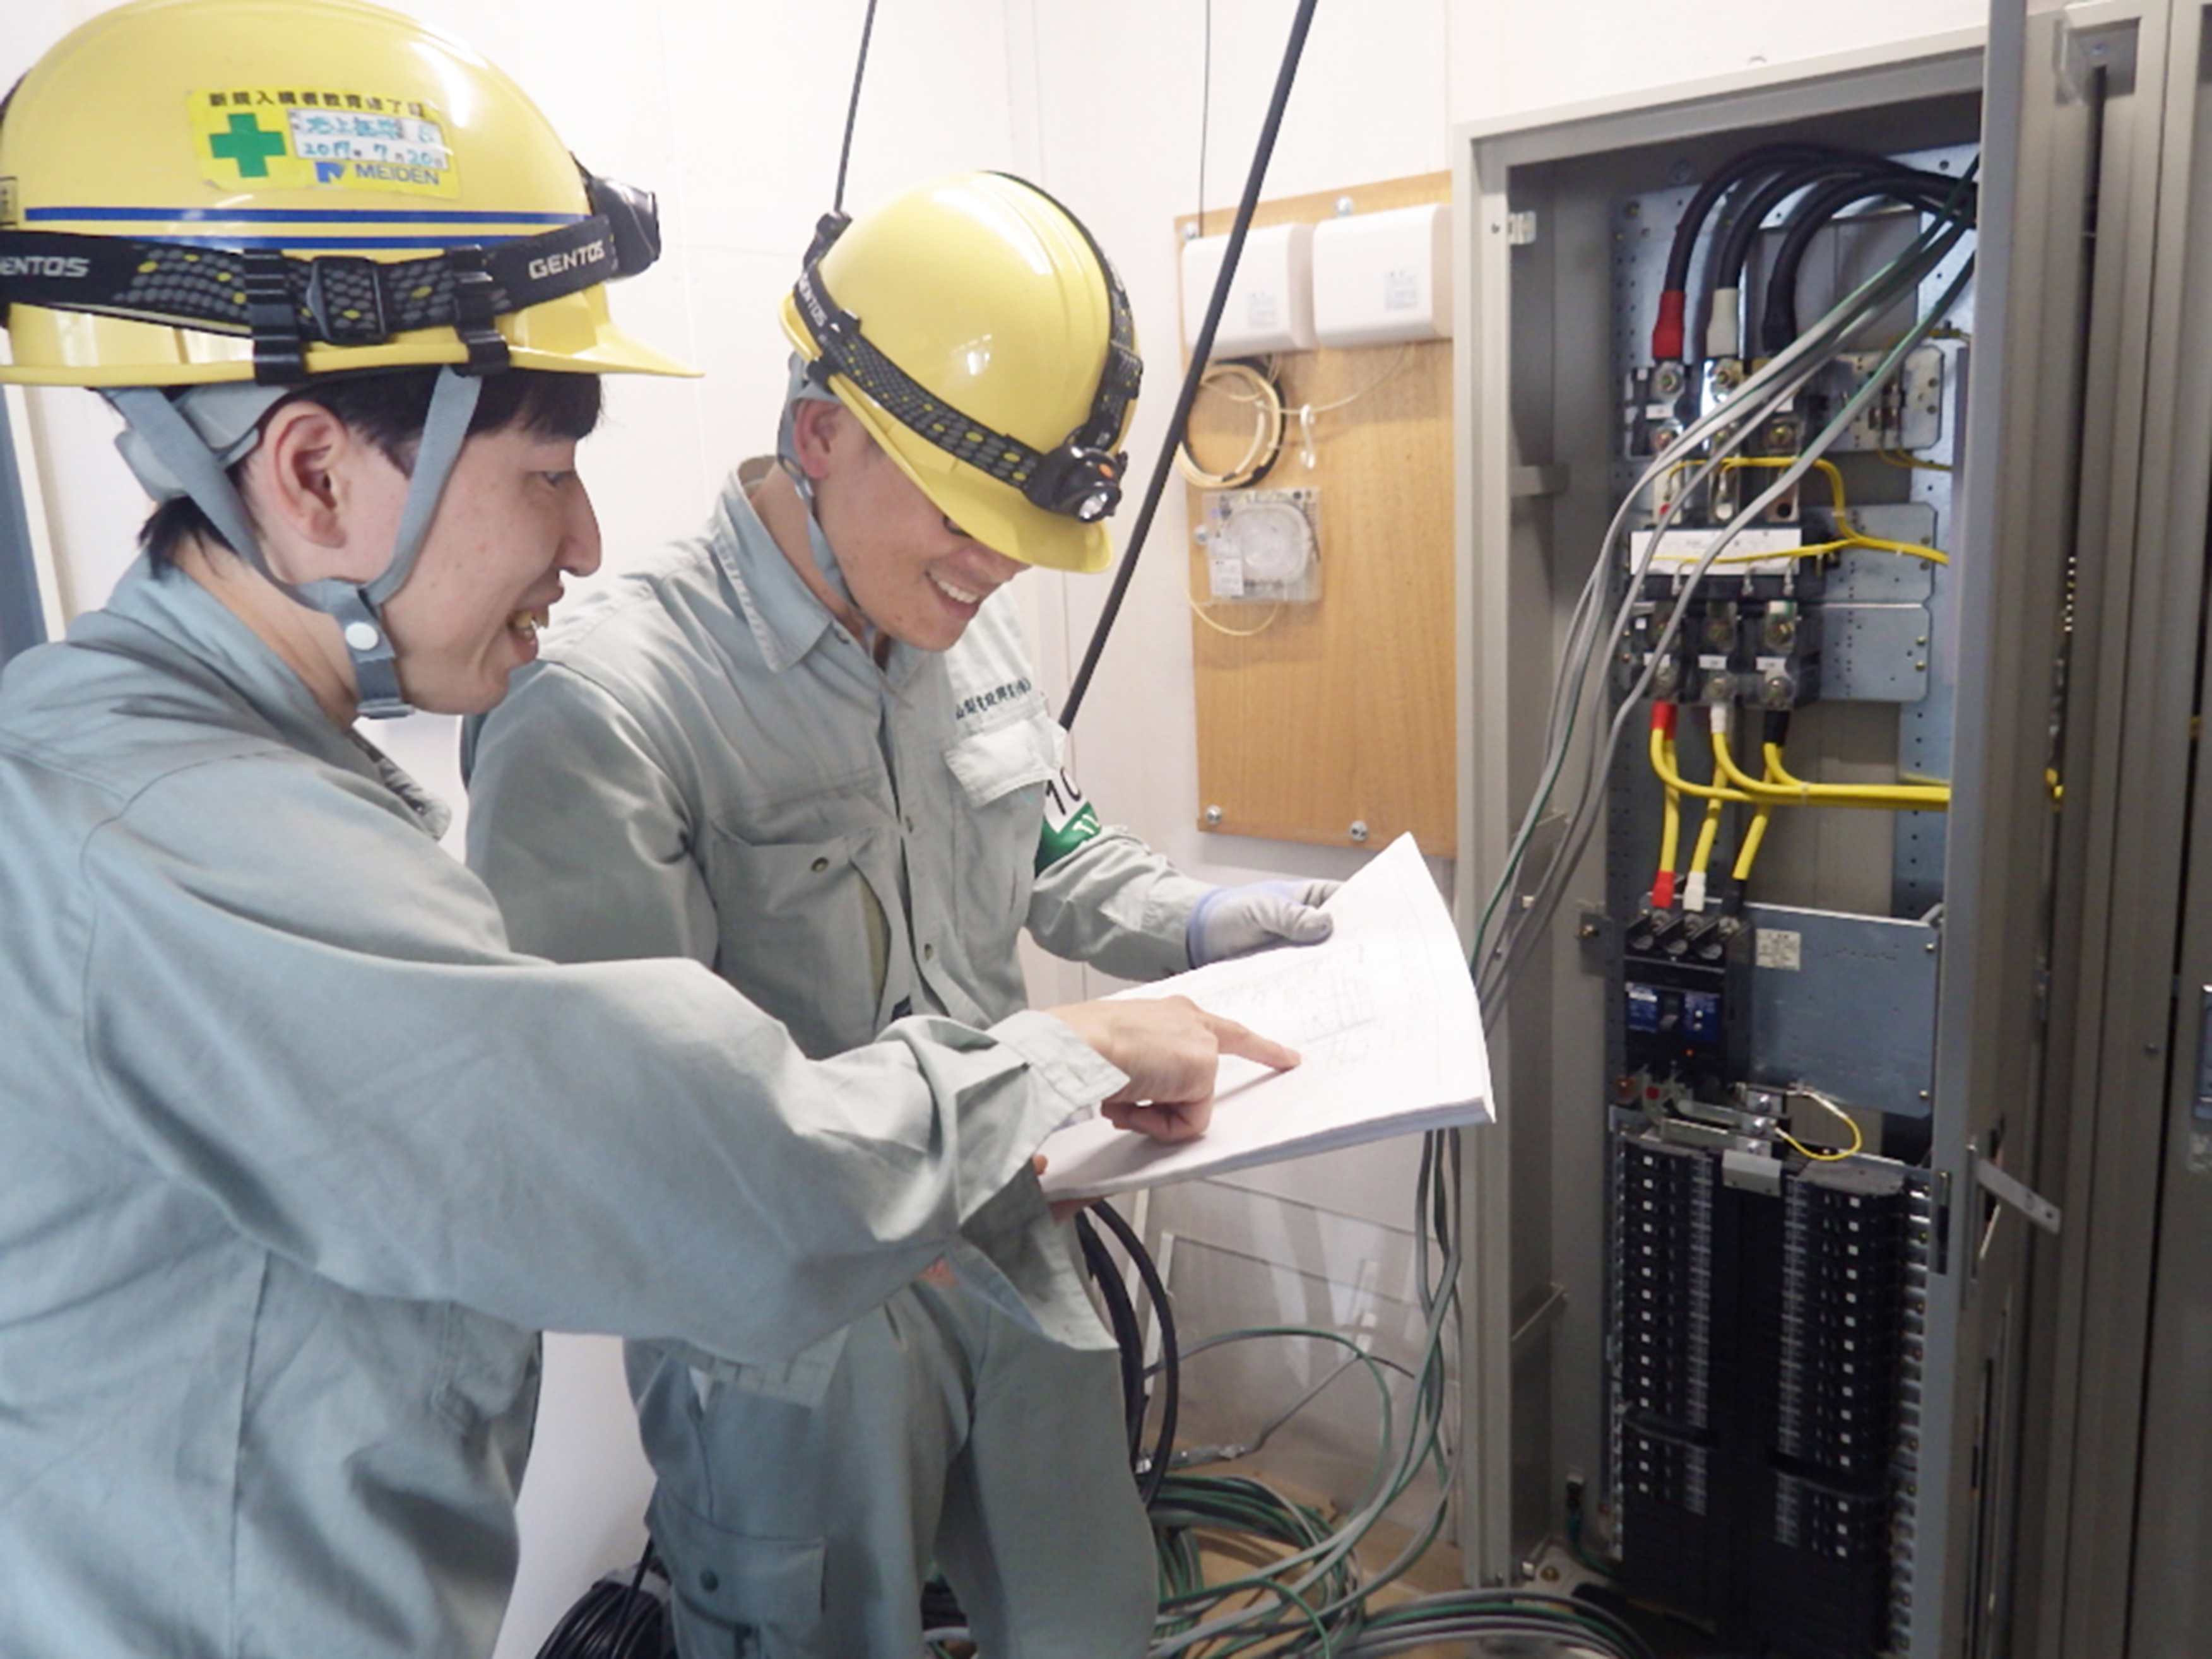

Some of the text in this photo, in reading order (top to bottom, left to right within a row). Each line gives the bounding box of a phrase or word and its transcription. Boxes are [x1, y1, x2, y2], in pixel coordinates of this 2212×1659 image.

[355, 163, 439, 185] MEIDEN
[0, 256, 90, 277] ENTOS
[528, 239, 604, 280] GENTOS
